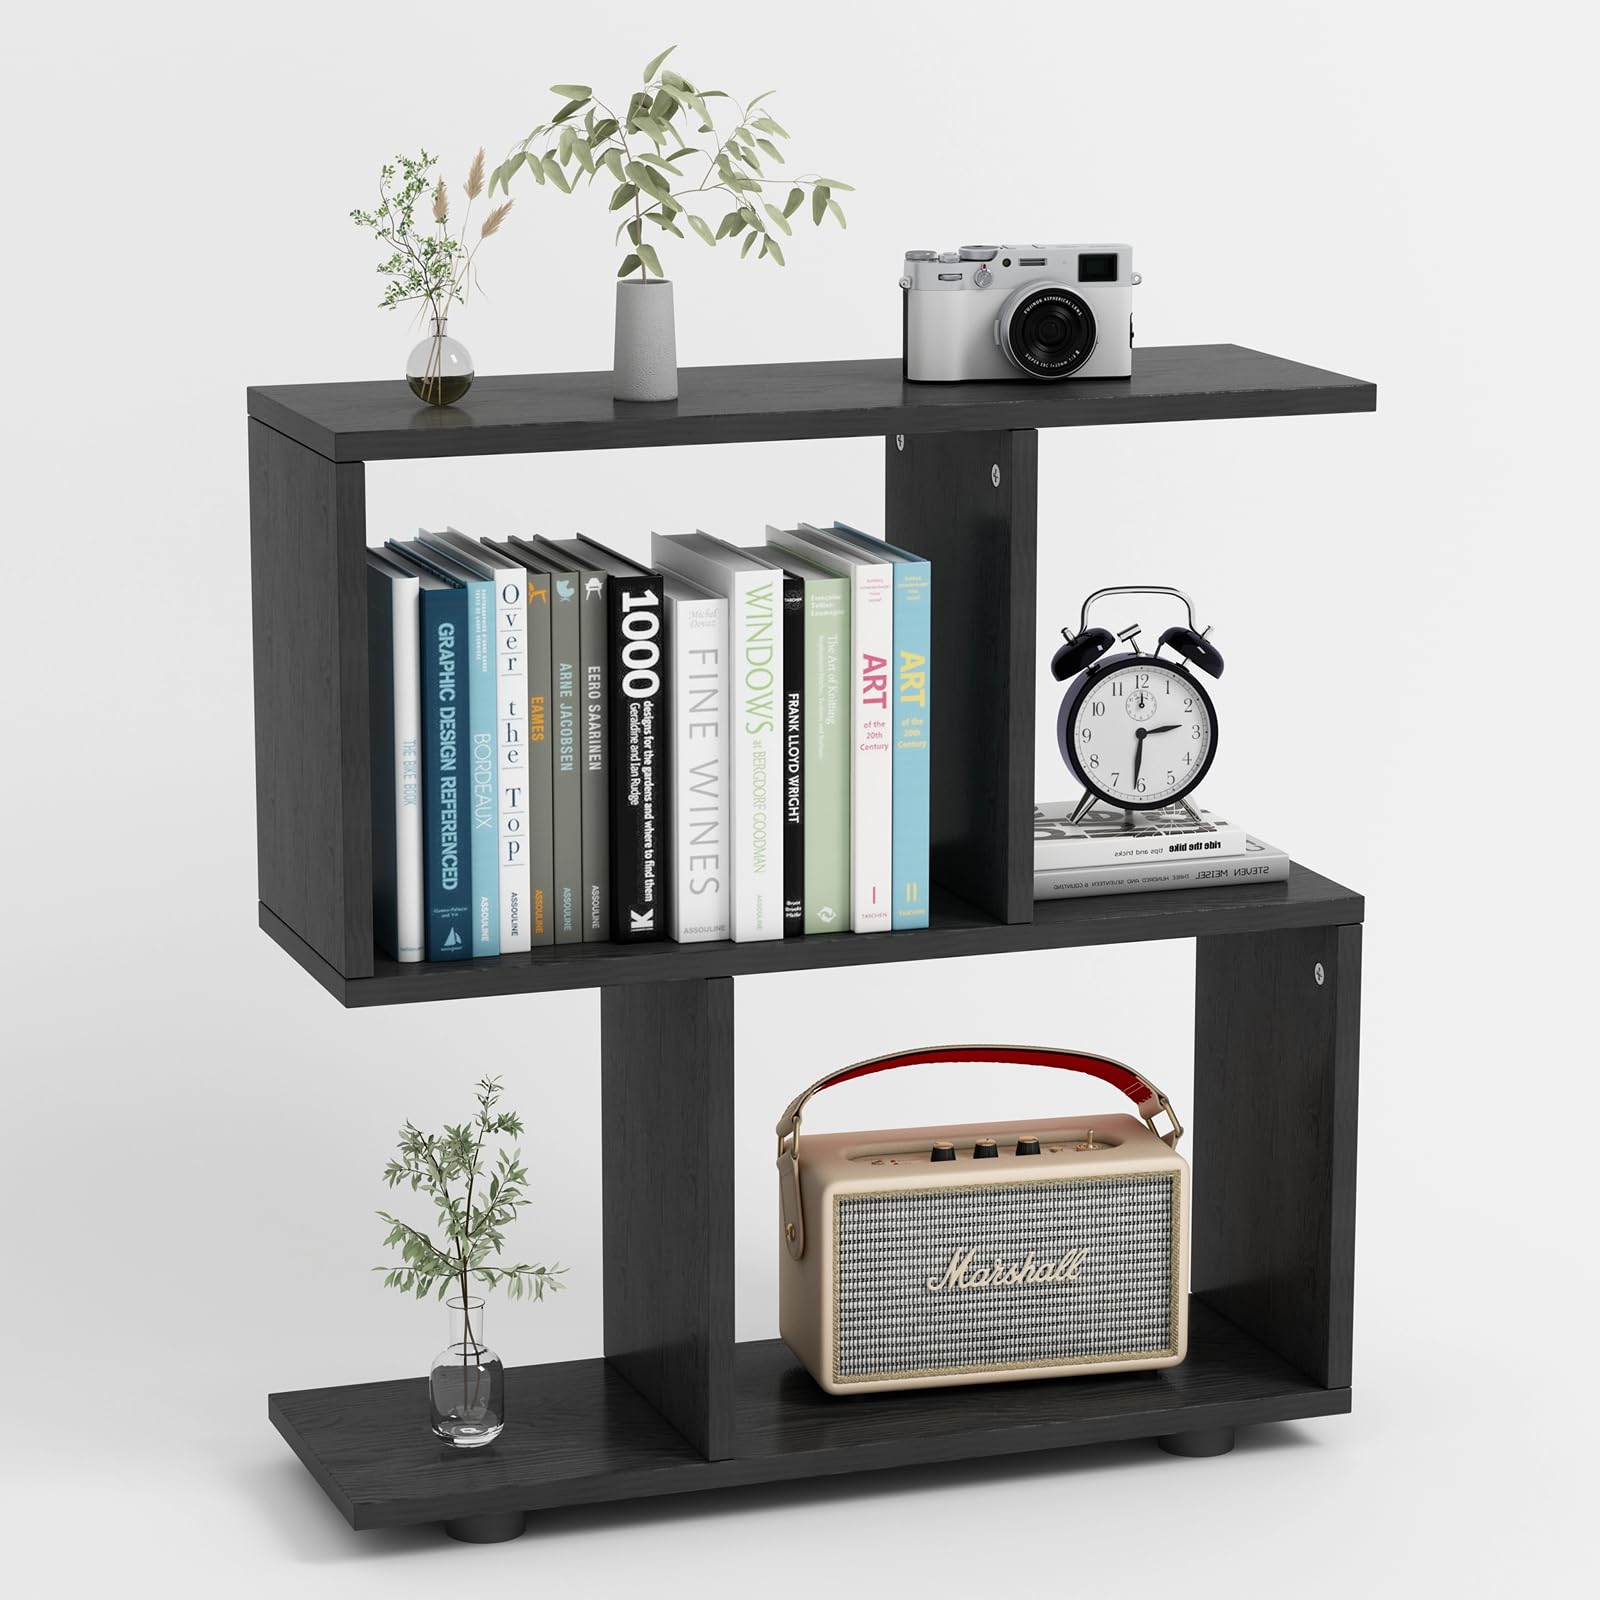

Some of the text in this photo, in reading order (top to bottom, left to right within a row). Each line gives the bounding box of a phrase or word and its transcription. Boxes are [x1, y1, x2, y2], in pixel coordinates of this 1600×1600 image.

[1043, 296, 1071, 306] ASPHERICAL
[1071, 303, 1083, 316] LENS
[437, 622, 455, 701] GRAPHIC
[621, 588, 660, 699] 1000
[827, 634, 838, 653] The
[827, 655, 838, 672] Art
[863, 653, 887, 709] ART
[900, 650, 926, 708] ART
[1112, 681, 1122, 696] 11
[1135, 673, 1149, 689] 12
[1165, 679, 1170, 695] 1
[502, 583, 521, 861] Over the Top
[531, 696, 545, 741] EAMES
[559, 662, 574, 771] ARNE JACOBSEN
[588, 666, 602, 770] EERO SAARINEN
[745, 582, 774, 873] WINDOWS at BERGDORF GOODMAN
[825, 686, 839, 725] Knitting
[864, 720, 885, 728] of the
[1092, 701, 1105, 716] 10
[1183, 698, 1193, 713] 2
[439, 707, 457, 771] DESIGN
[628, 702, 641, 806] Geraldine and Ian Rudge
[860, 743, 889, 751] Century
[866, 732, 882, 740] 20th
[1082, 728, 1092, 743] 9
[1191, 724, 1201, 740] 3
[403, 739, 417, 806] THE BIKE BOOK
[688, 649, 720, 895] FINE WINES
[788, 693, 800, 823] FRANK LLOYD WRIGHT
[1089, 753, 1099, 769] 8
[1110, 772, 1120, 787] 7
[1166, 770, 1176, 786] 5
[1181, 752, 1192, 765] 4
[473, 733, 492, 830] BORDEAUX
[641, 700, 655, 902] designs for the gardens and where to find them
[1136, 777, 1146, 793] 6
[440, 776, 458, 891] REFERENCED
[480, 896, 489, 944] ASSOULINE
[510, 892, 519, 937] ASSOULINE
[534, 888, 544, 935] ASSOULINE
[562, 887, 572, 932] ASSOULINE
[591, 885, 600, 929] ASSOULINE
[683, 925, 726, 935] ASSOULINE
[926, 1247, 1088, 1291] Marshall
